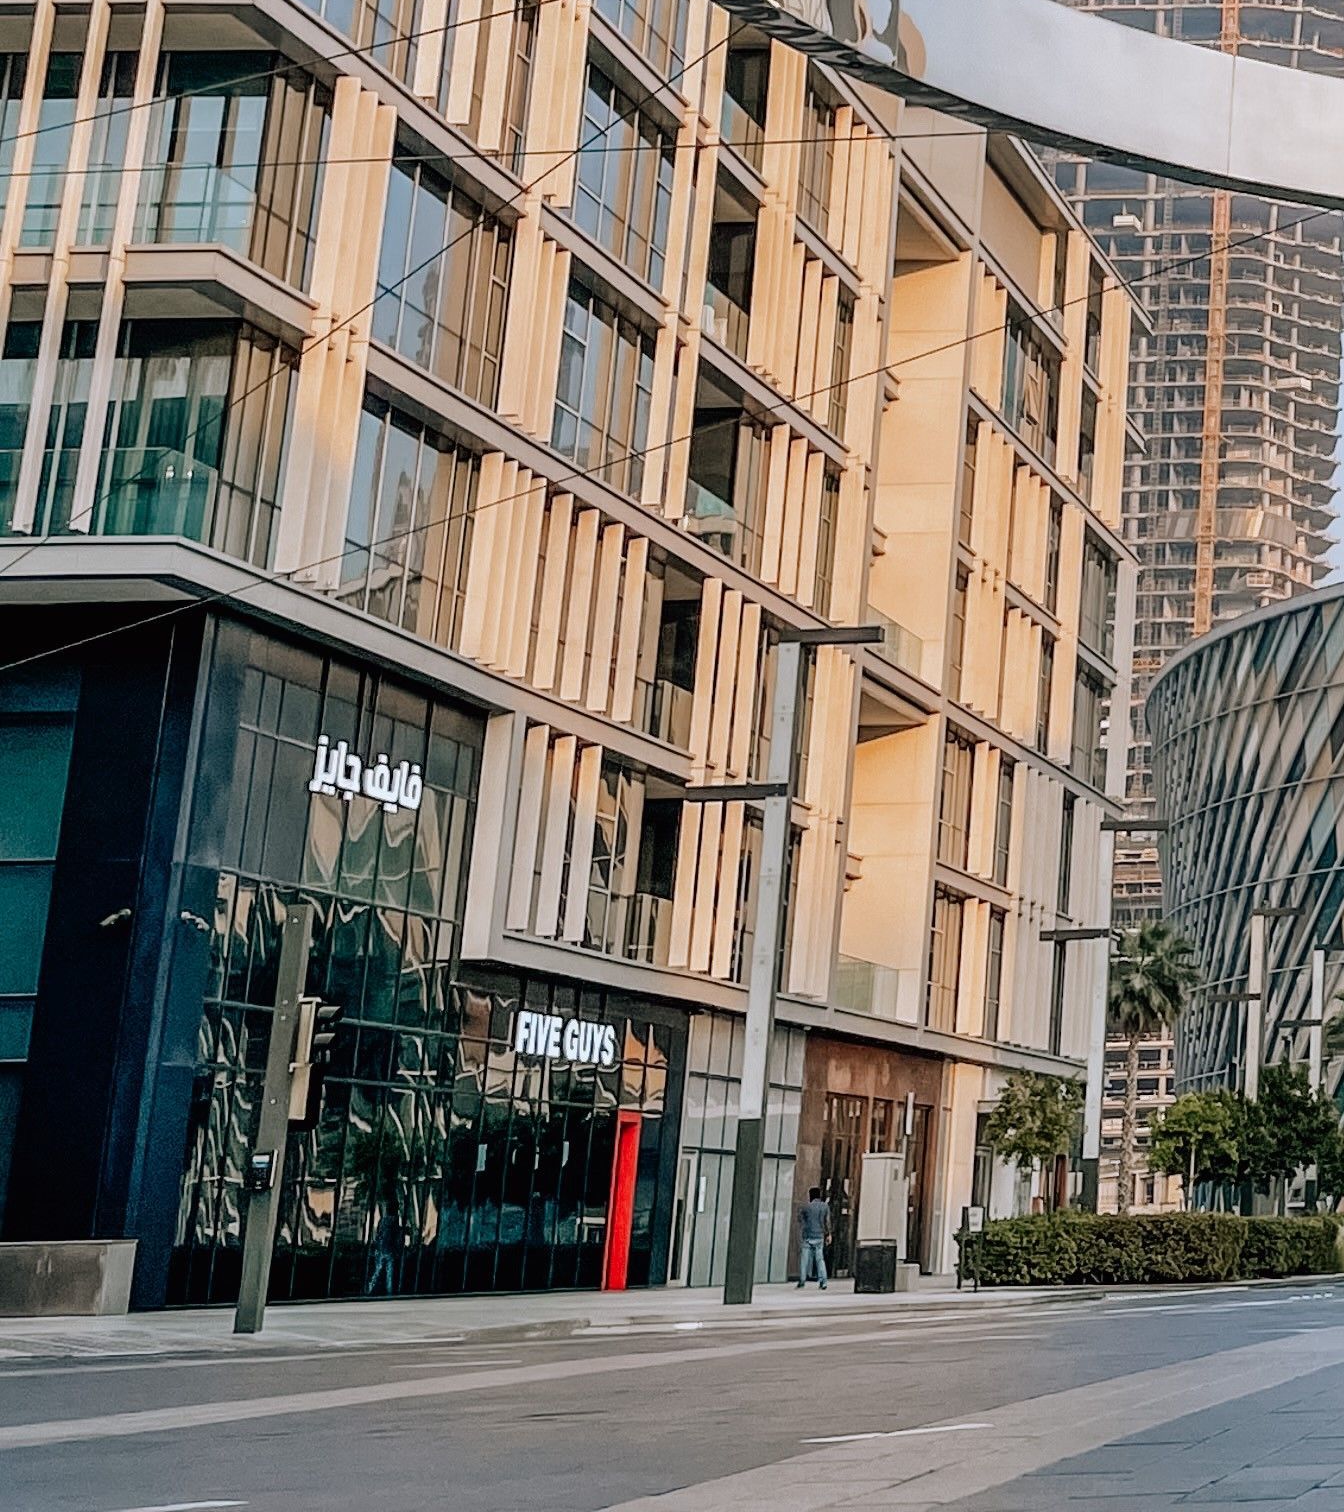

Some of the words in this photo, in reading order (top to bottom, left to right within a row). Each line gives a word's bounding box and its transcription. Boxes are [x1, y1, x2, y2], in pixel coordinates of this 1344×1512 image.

[309, 734, 361, 801] جايز
[362, 753, 422, 813] فايف
[516, 1011, 562, 1058] FIVE
[563, 1018, 615, 1066] GUYS
